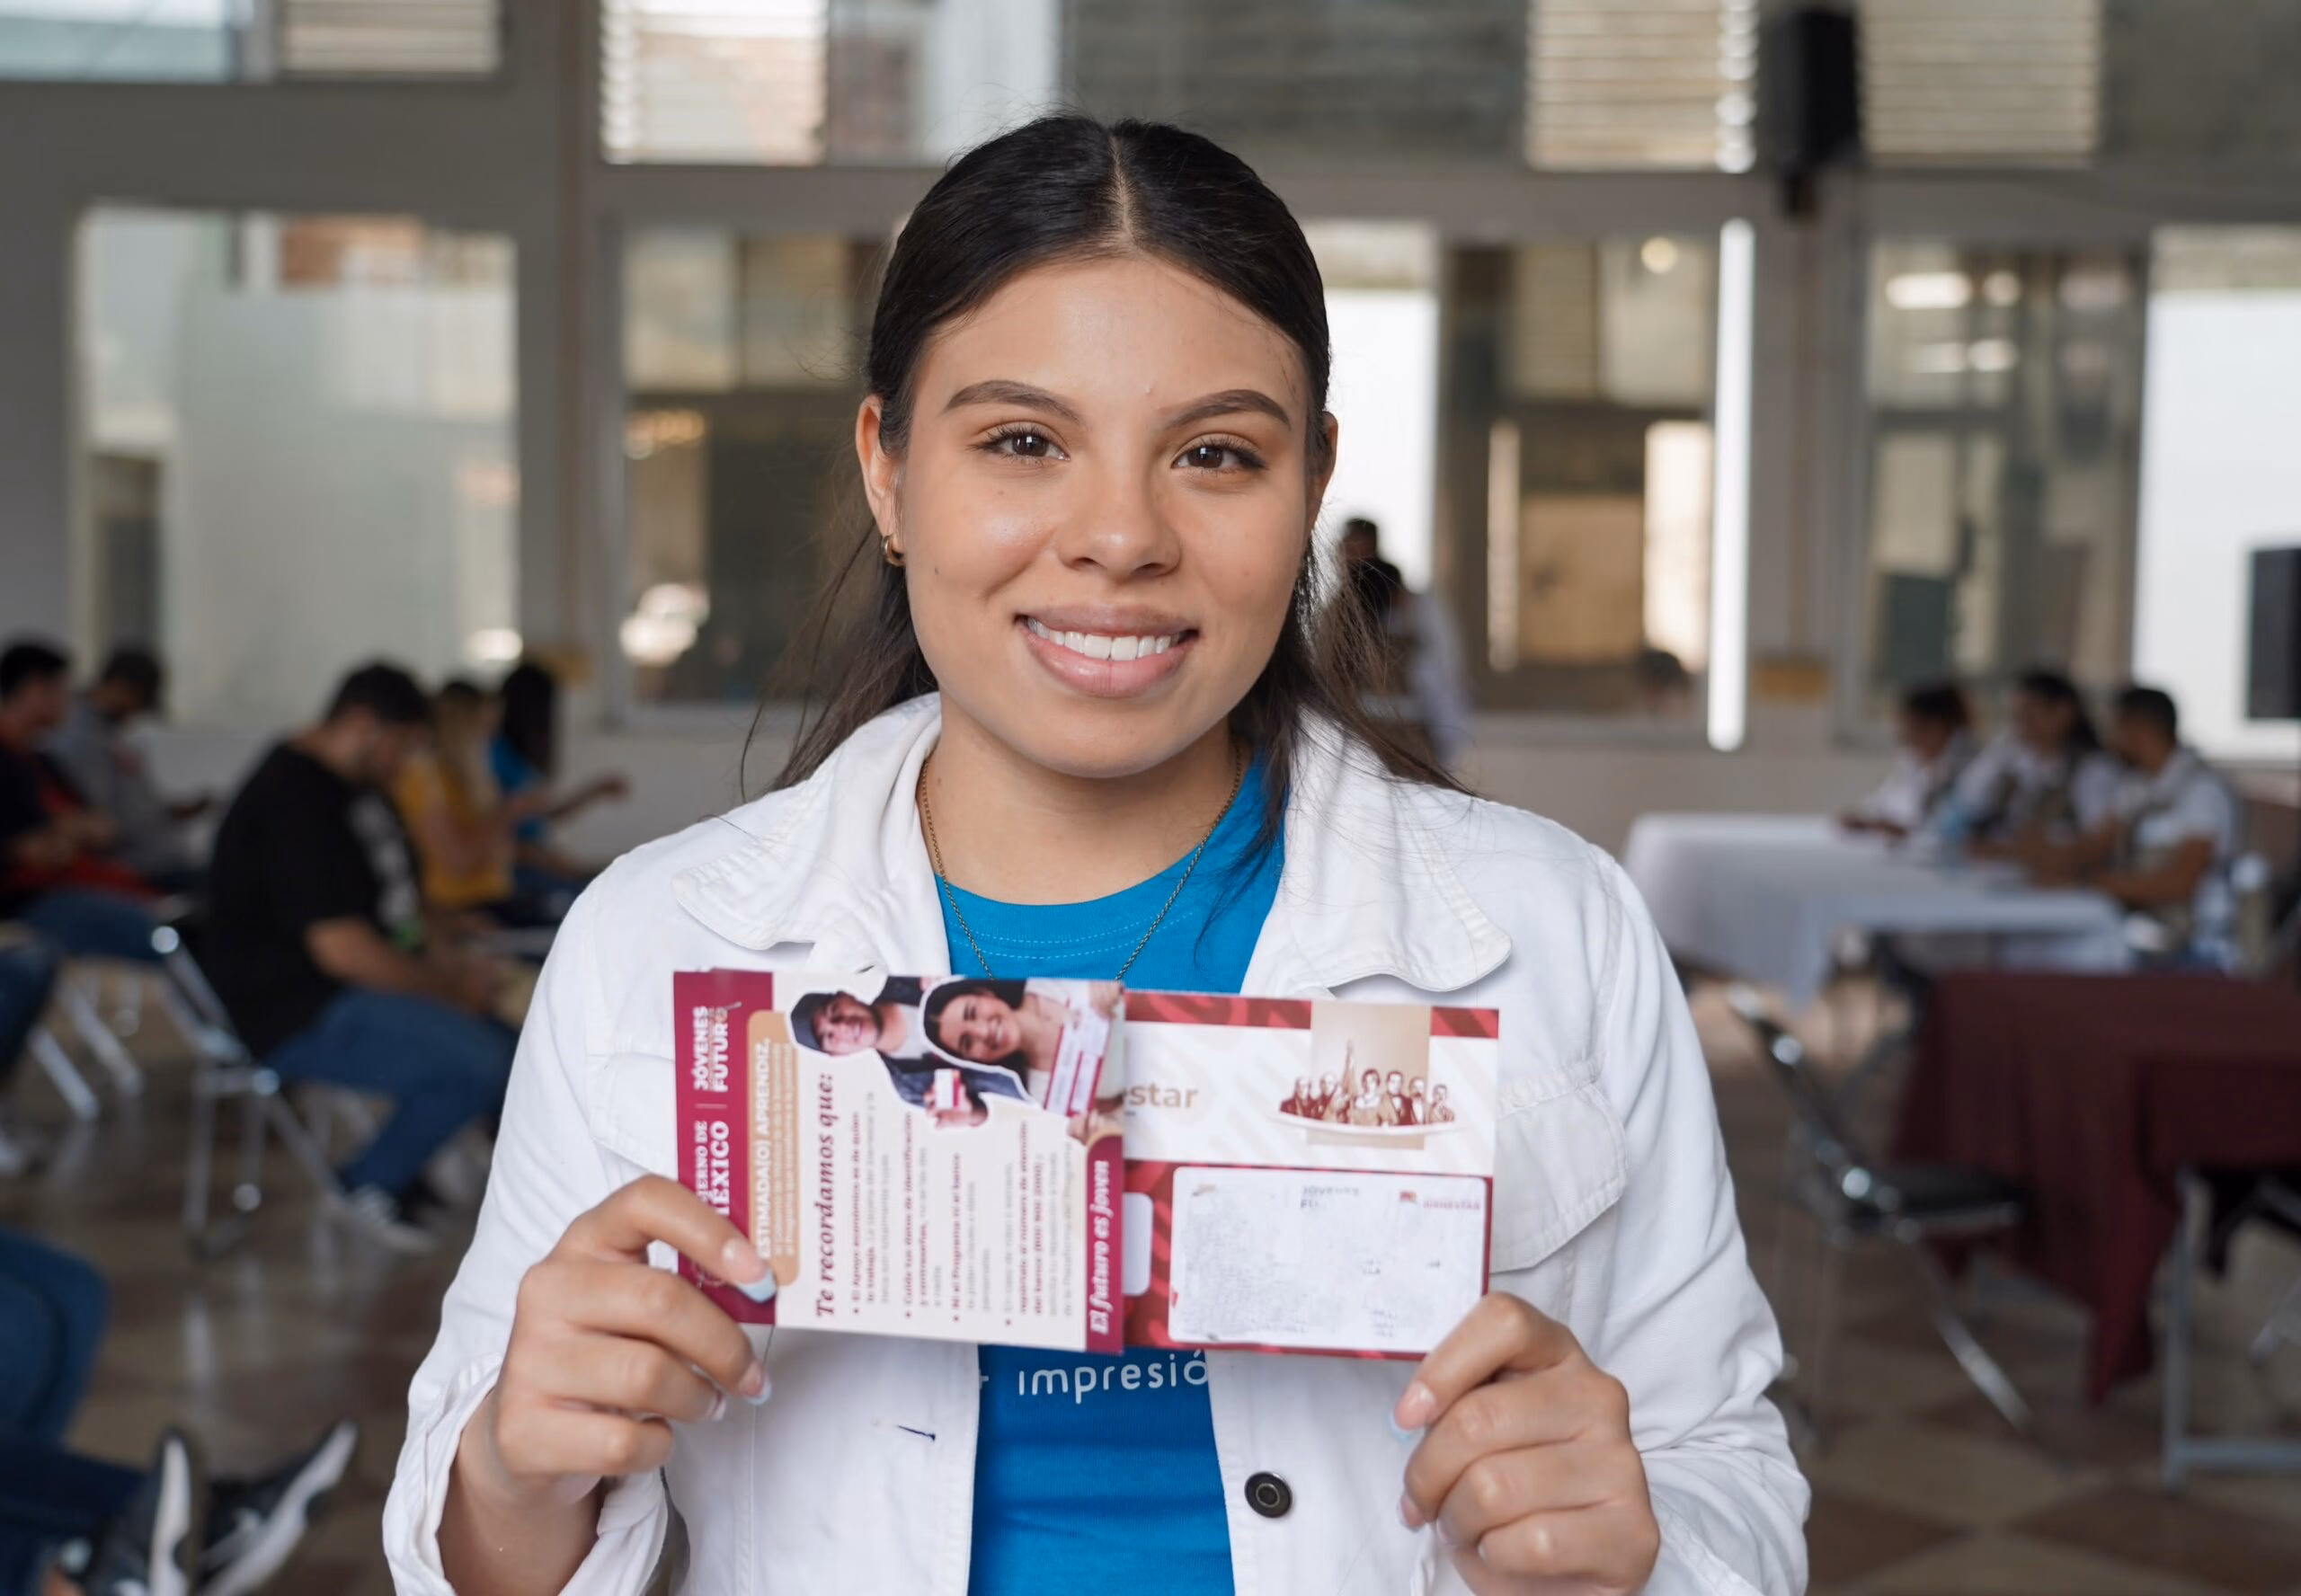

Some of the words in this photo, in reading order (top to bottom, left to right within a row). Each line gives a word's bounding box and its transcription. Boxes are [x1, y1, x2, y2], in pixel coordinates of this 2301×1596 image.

[690, 1006, 708, 1091] JÓVENES
[819, 1074, 839, 1127] que:
[695, 1120, 708, 1144] DE
[755, 1140, 771, 1258] ESTIMADA(O)
[814, 1134, 834, 1282] recordamos
[1089, 1159, 1114, 1218] joven
[1093, 1217, 1109, 1238] es
[815, 1290, 834, 1317] Te
[1088, 1241, 1114, 1312] futuro
[1089, 1310, 1108, 1334] El
